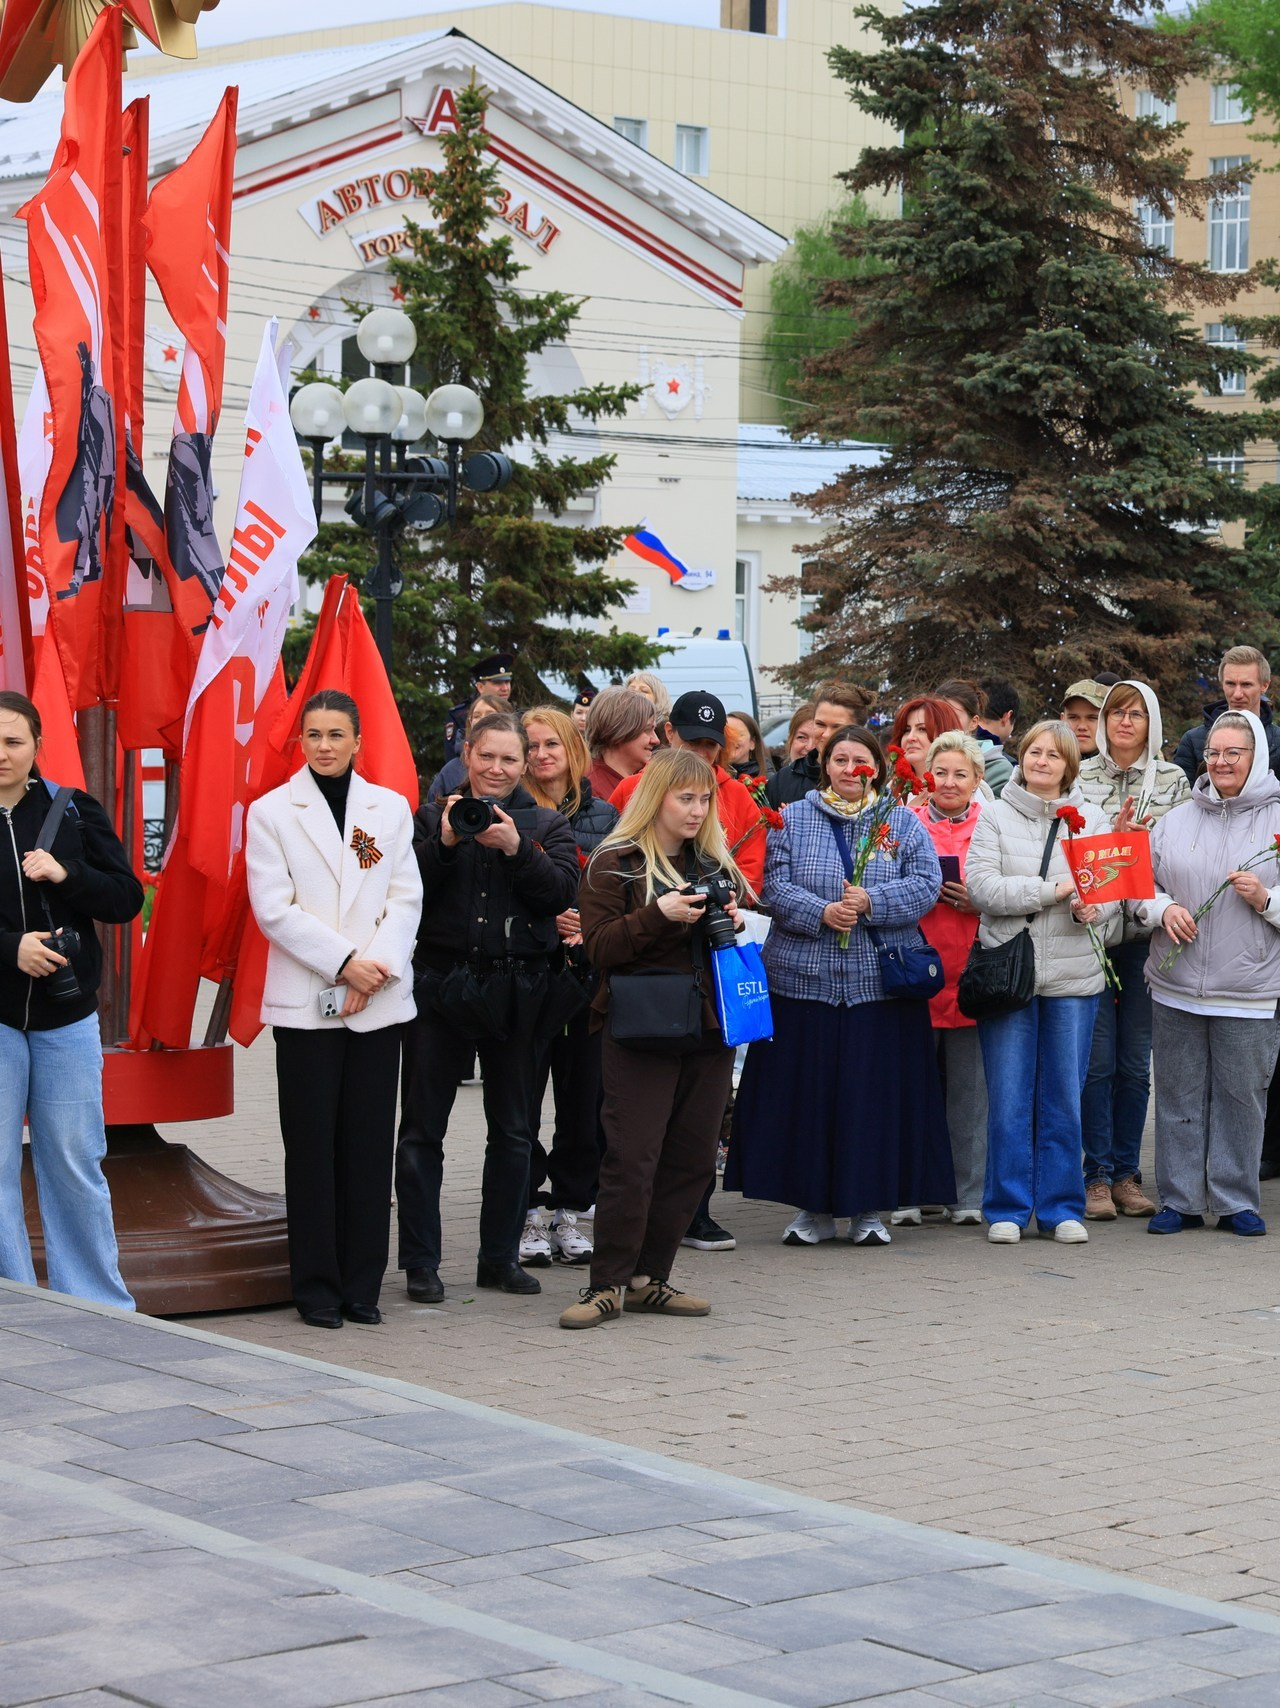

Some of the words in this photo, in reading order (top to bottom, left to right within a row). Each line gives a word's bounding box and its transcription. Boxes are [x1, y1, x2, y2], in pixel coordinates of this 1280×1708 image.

[316, 165, 561, 256] АВТОВЗАЛ
[212, 500, 287, 630] ЛЫ
[1083, 850, 1096, 863] 9
[1097, 846, 1133, 860] МАЯ
